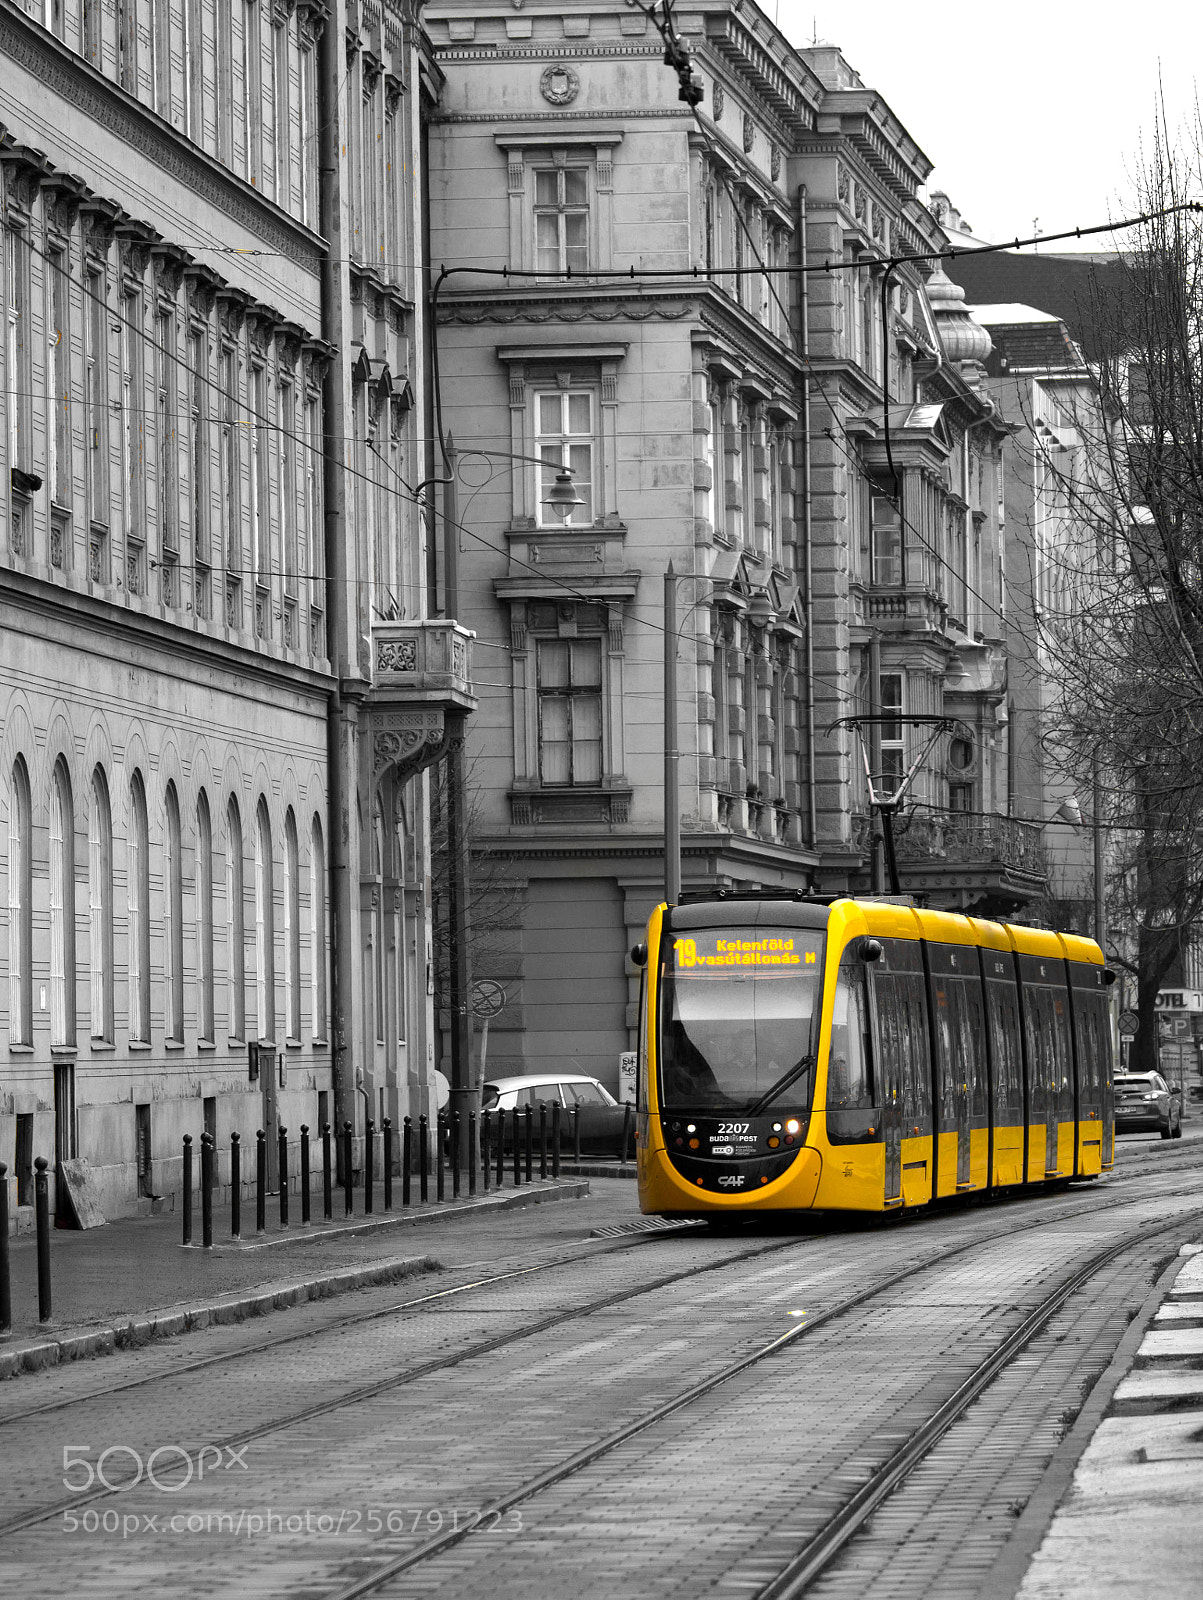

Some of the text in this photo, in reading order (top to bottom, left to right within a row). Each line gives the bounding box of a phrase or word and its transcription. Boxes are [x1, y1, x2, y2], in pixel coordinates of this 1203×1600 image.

[716, 939, 794, 952] Kelenföld
[673, 938, 696, 967] 19
[696, 952, 816, 966] vasútállomás M
[1174, 1020, 1187, 1035] P
[717, 1123, 750, 1134] 2207
[717, 1175, 745, 1187] CAF
